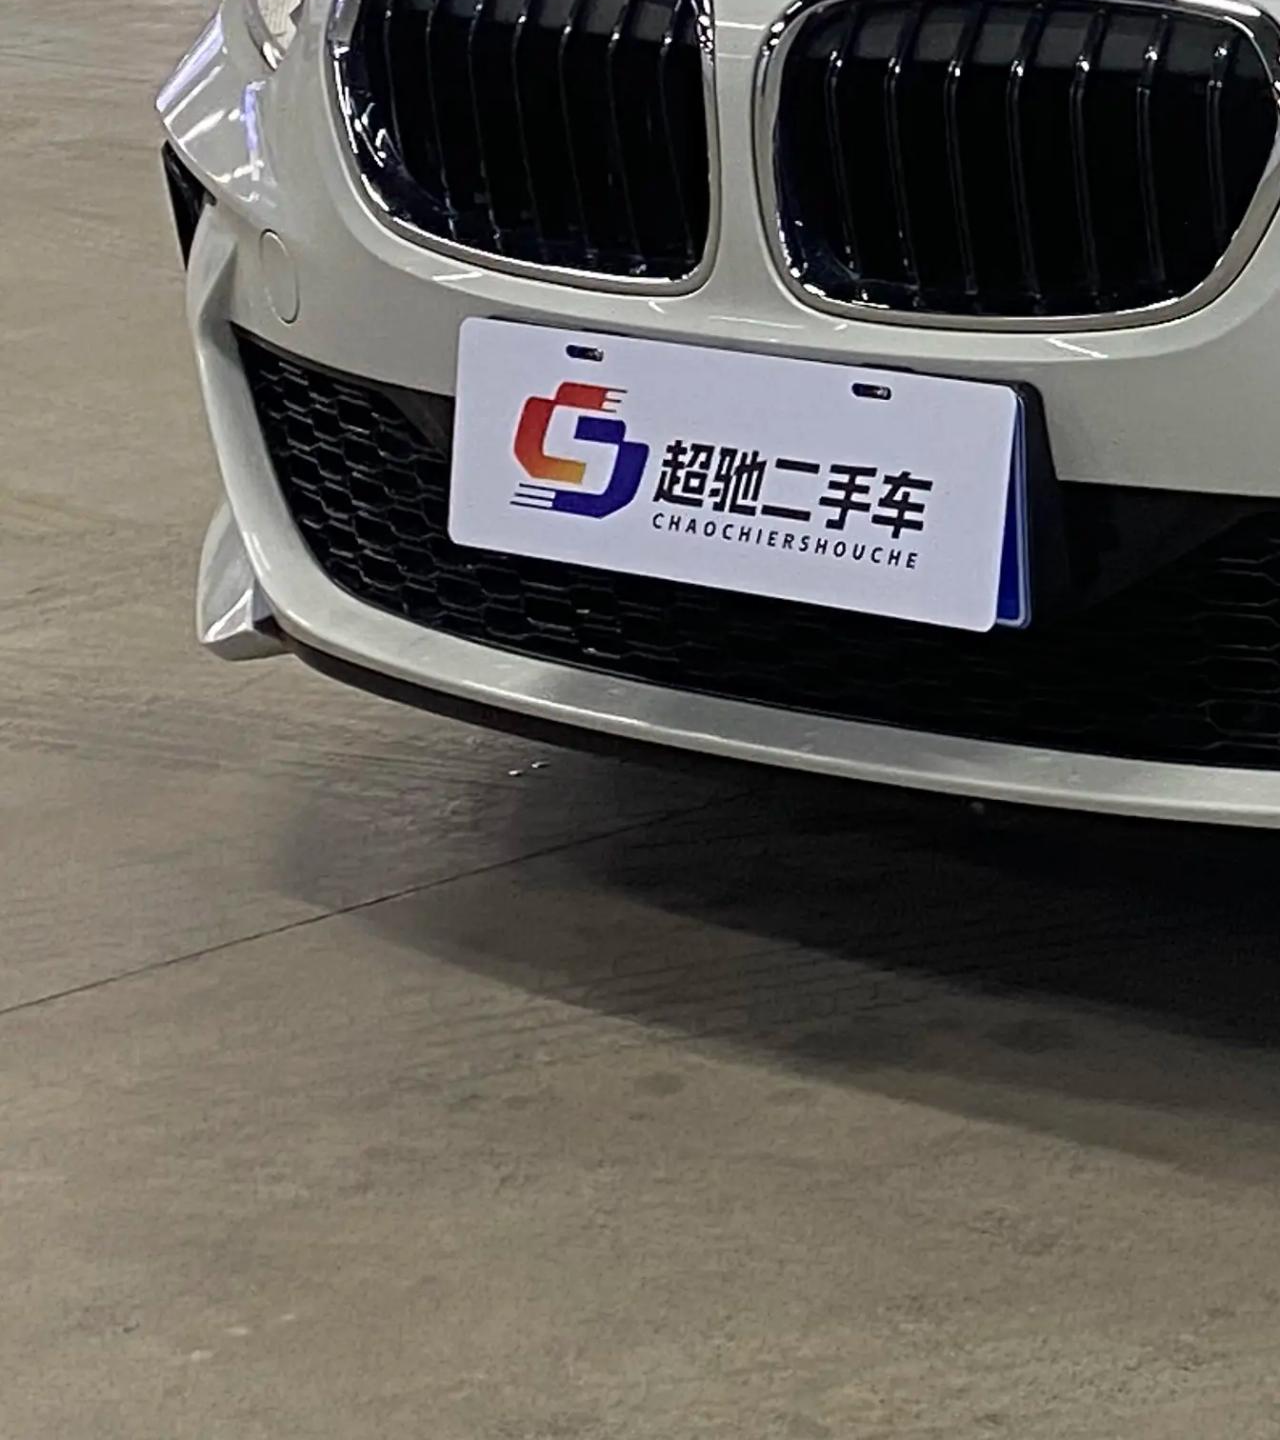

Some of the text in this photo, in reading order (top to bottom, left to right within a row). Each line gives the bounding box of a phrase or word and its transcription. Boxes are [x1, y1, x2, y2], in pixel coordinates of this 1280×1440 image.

[652, 440, 933, 539] 超驰二手车
[652, 513, 918, 569] CHAOCHIERSHOUCHE
